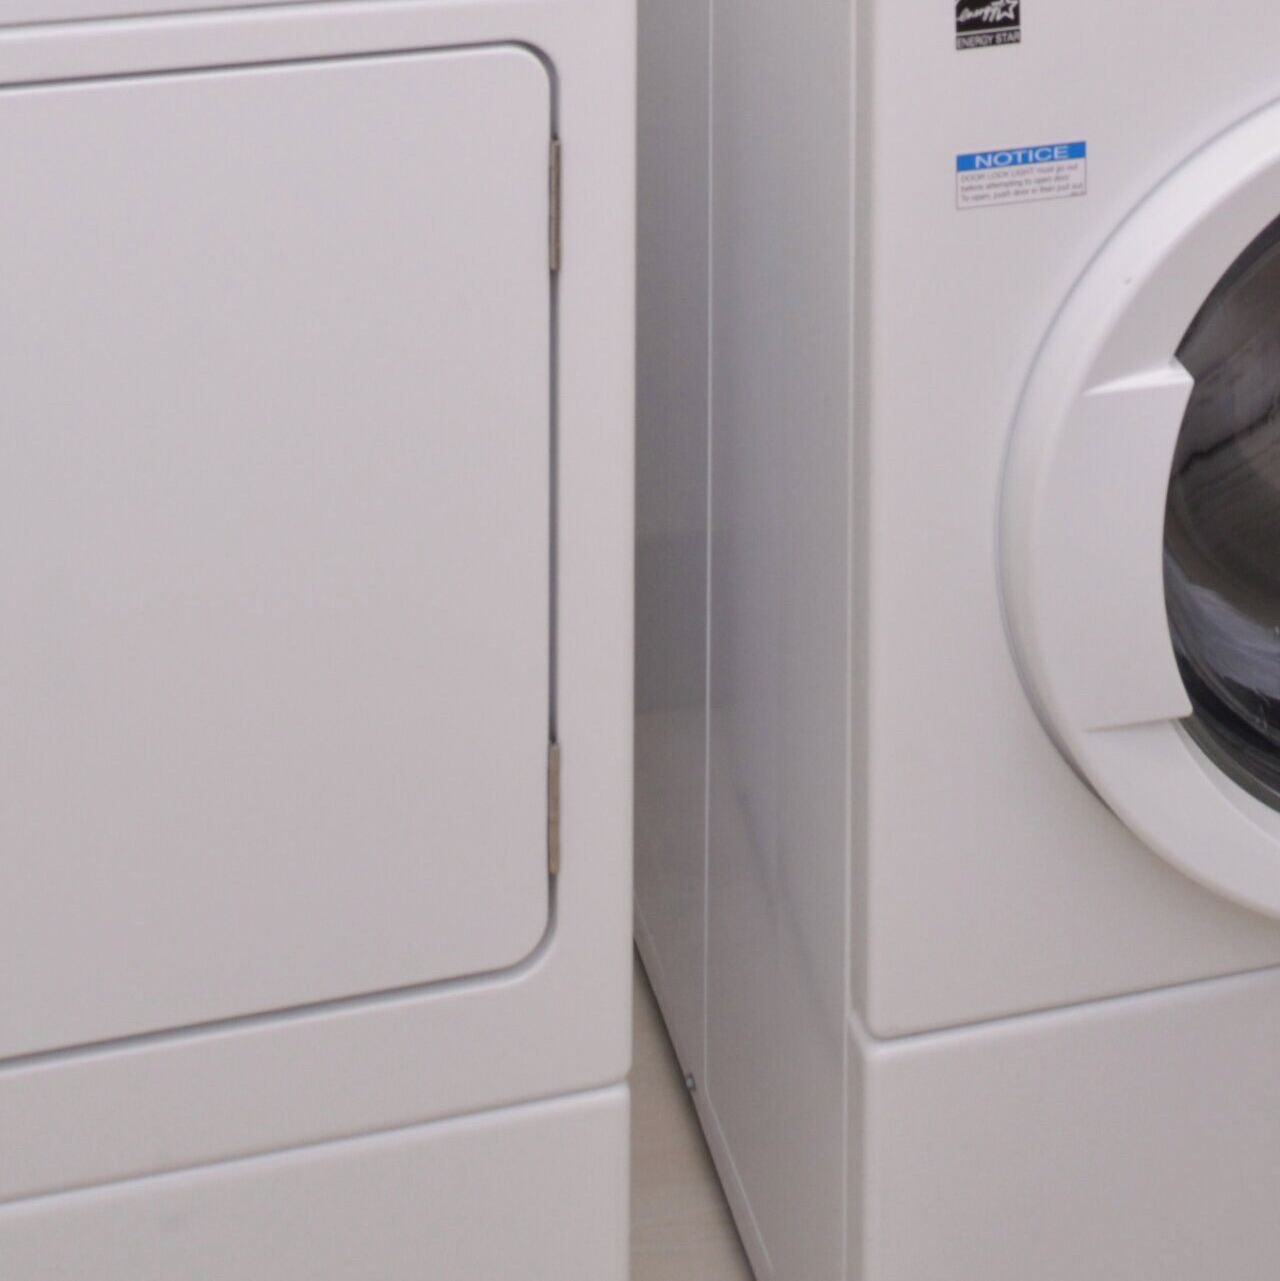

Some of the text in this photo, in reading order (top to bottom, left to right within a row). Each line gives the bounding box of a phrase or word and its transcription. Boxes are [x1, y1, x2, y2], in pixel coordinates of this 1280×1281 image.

[956, 30, 1020, 49] ENERGY STAR
[975, 145, 1069, 169] NOTICE
